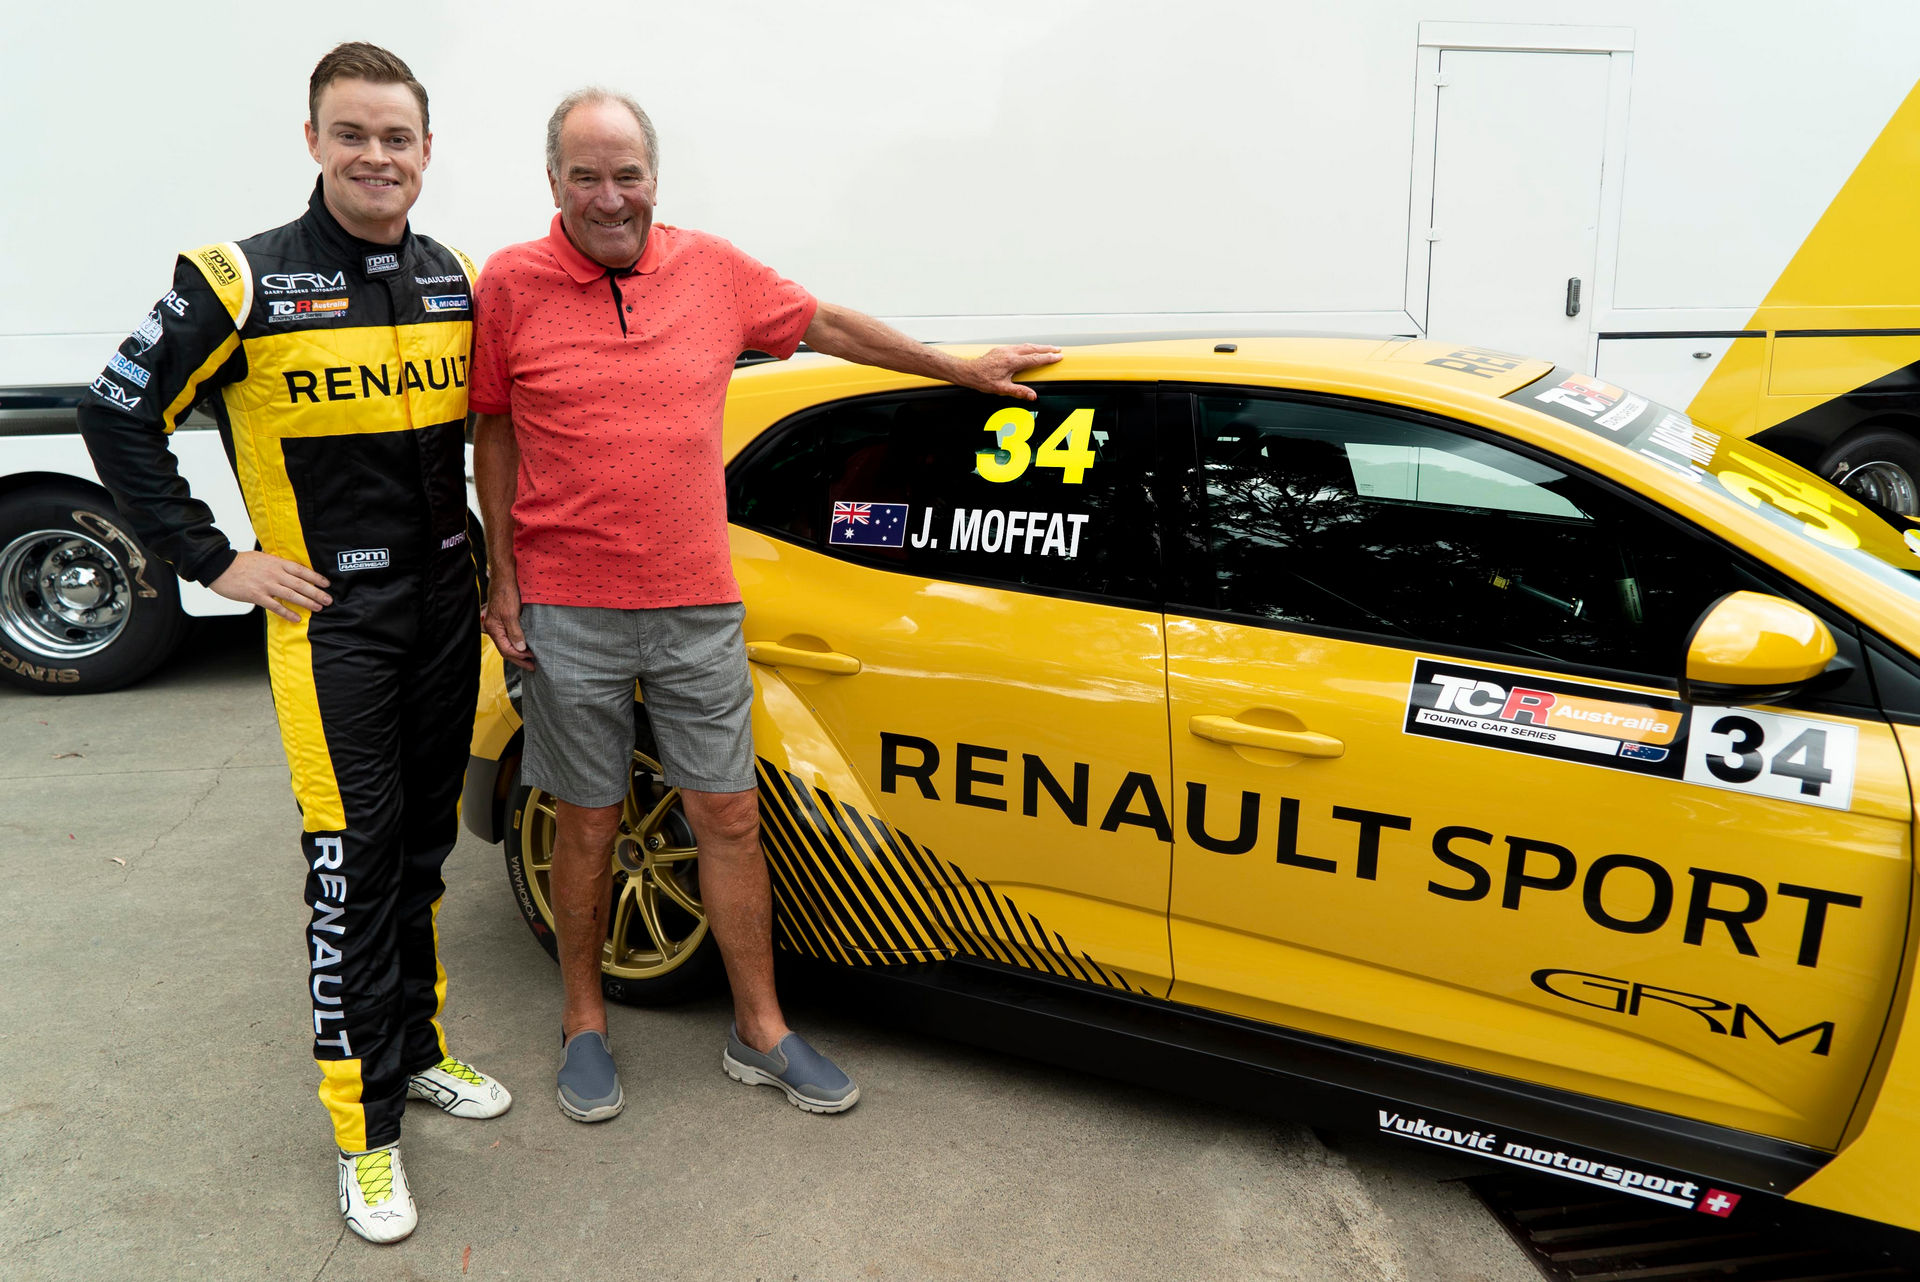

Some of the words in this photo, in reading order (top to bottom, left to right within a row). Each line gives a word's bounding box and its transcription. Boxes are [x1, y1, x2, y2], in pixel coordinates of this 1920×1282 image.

[208, 249, 236, 280] rpm
[261, 270, 346, 290] GRM
[367, 254, 395, 266] rpm
[268, 300, 312, 316] TCR
[313, 301, 347, 309] Australia
[311, 285, 347, 293] MOTORSPORT
[271, 315, 294, 323] Touring
[282, 354, 467, 404] RENAULT
[976, 407, 1097, 485] 34
[1716, 450, 1862, 550] 34
[342, 550, 386, 563] rpm
[911, 507, 938, 549] J.
[949, 508, 1090, 558] MOFFAT
[341, 560, 389, 570] RACEWEAR
[1423, 712, 1478, 729] TOURING
[1481, 721, 1509, 733] CAR
[1510, 727, 1557, 742] SERIES
[1430, 673, 1557, 727] TCR
[1553, 704, 1670, 735] Australia
[1705, 715, 1833, 797] 34
[880, 731, 1412, 881] RENAULT
[1427, 825, 1863, 969] SPORT
[511, 855, 537, 921] YOKOHAMA
[311, 835, 353, 1057] RENAULT
[1530, 968, 1836, 1057] GRM
[1378, 1109, 1496, 1152] Vuković
[1503, 1138, 1700, 1200] motorsport
